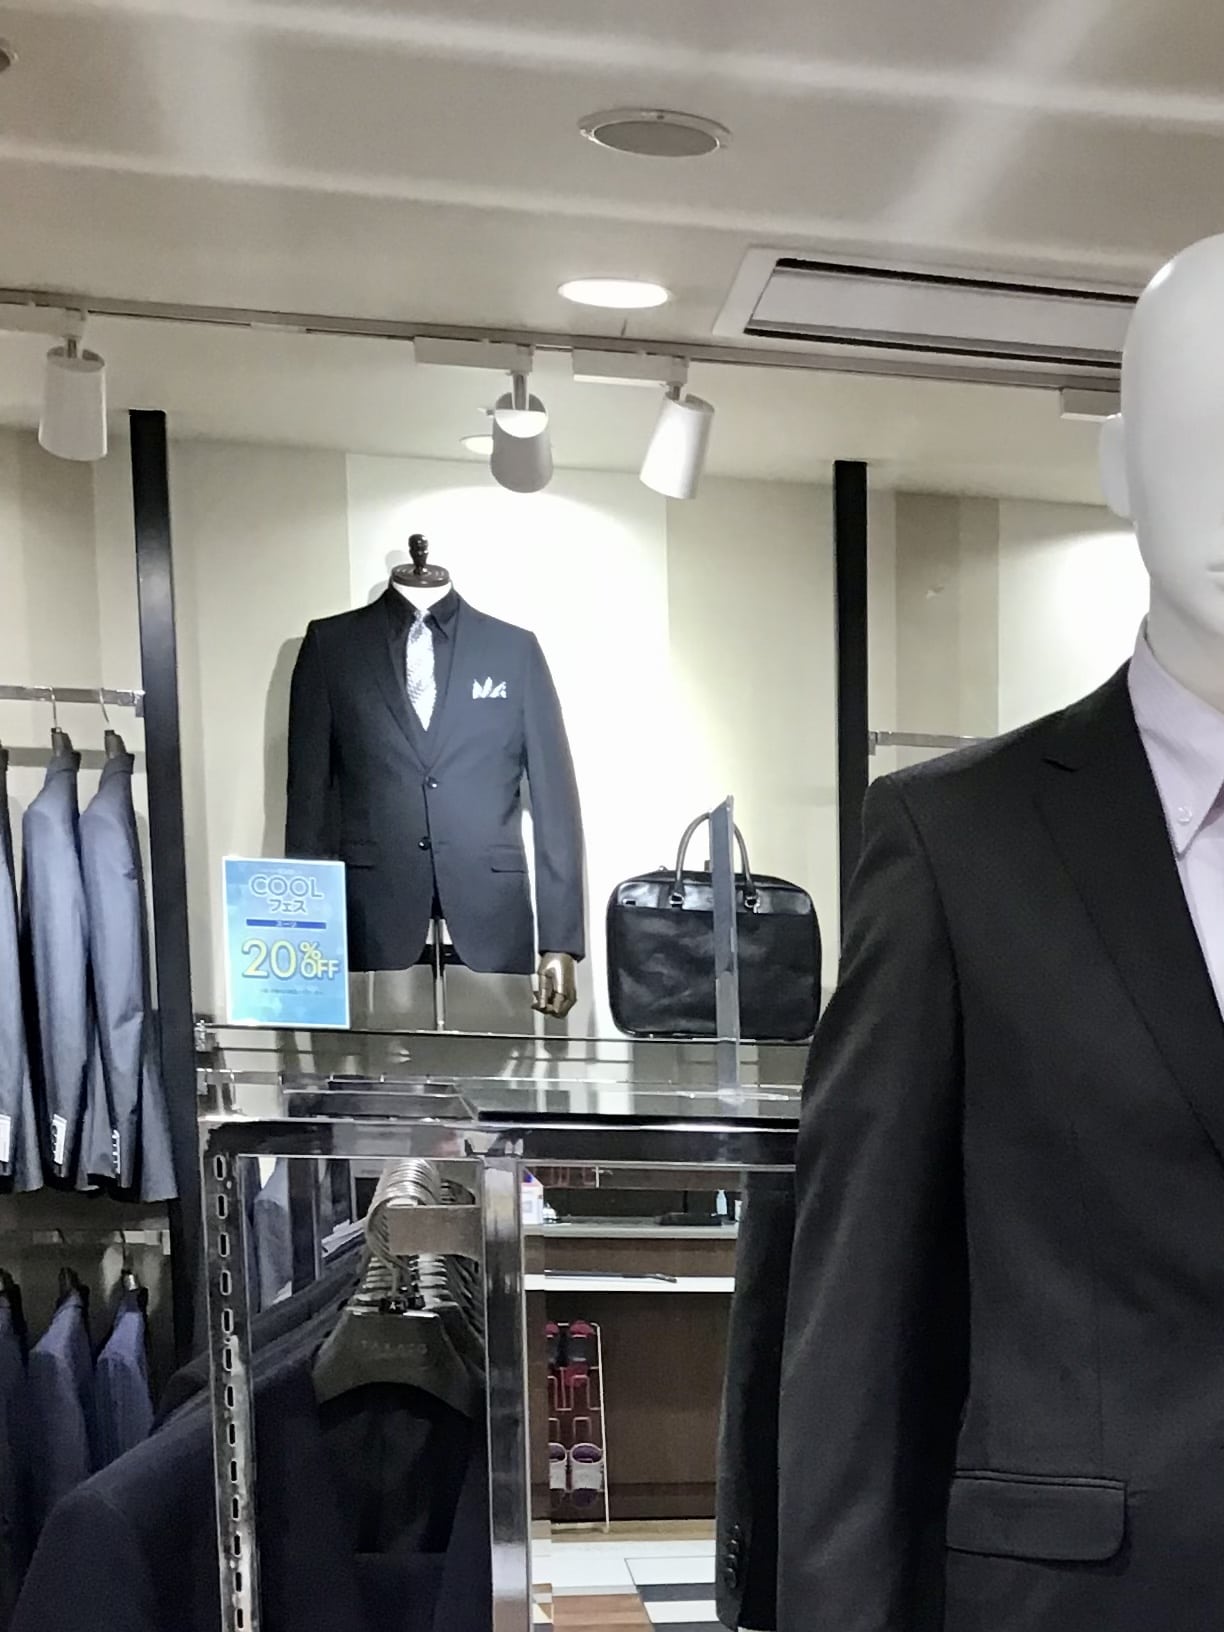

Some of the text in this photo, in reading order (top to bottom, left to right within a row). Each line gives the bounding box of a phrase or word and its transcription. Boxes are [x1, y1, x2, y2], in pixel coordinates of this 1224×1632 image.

[249, 873, 324, 899] COOL
[267, 898, 307, 913] フェス
[301, 959, 340, 980] OFF
